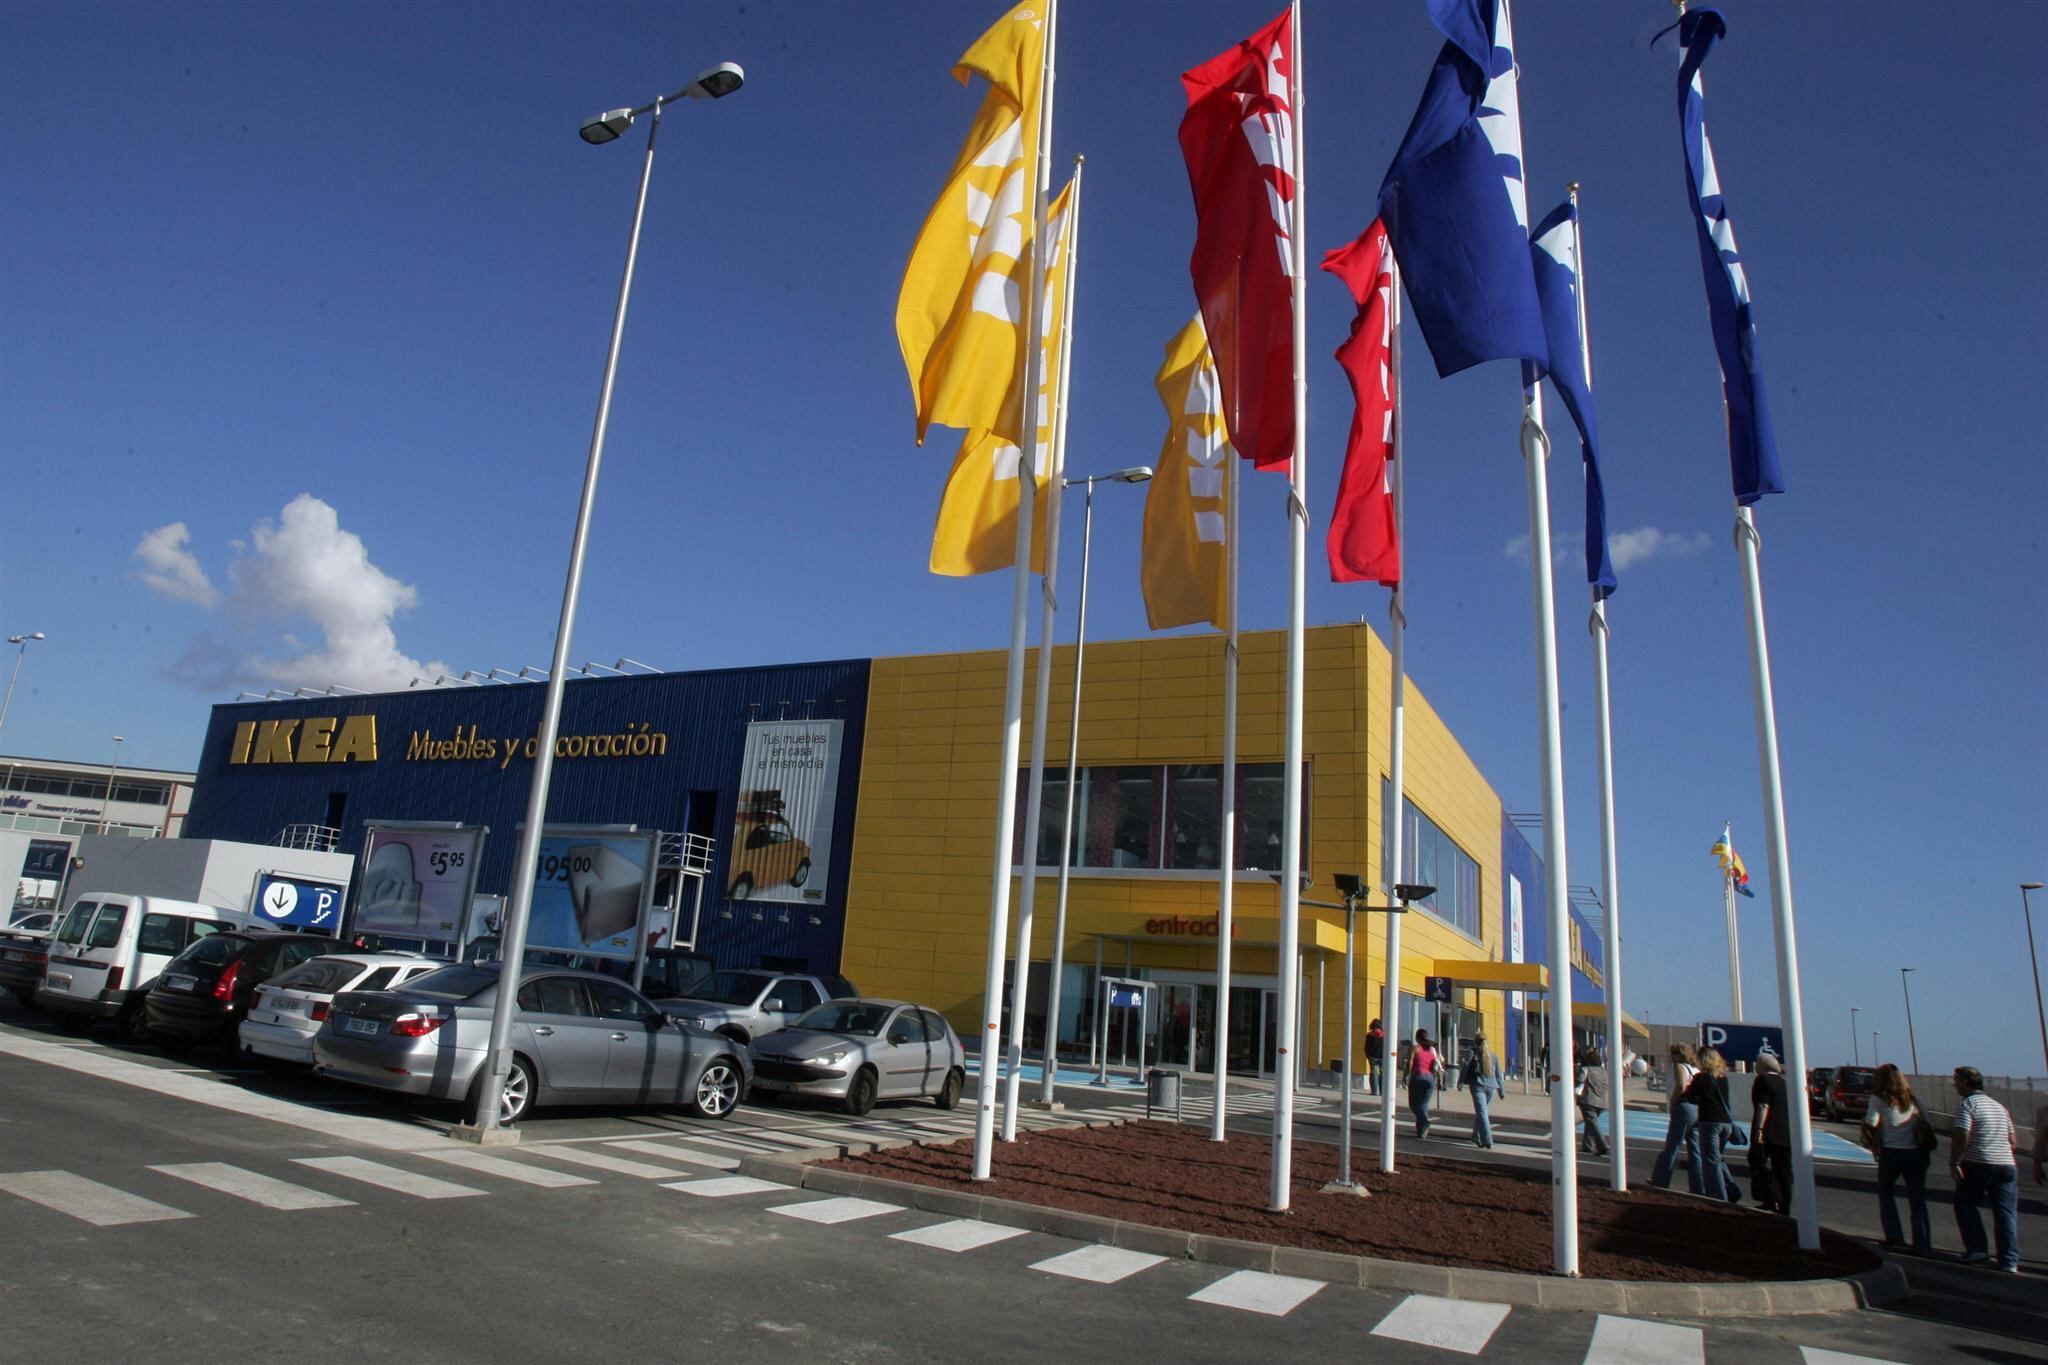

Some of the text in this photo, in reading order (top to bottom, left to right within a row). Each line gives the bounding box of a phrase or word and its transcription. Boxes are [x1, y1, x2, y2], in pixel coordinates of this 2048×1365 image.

[229, 714, 377, 764] IKEA
[405, 722, 667, 769] Muebles y dcoración
[763, 732, 827, 744] Tus muebles
[772, 747, 812, 757] en casa
[770, 759, 804, 769] mismo
[317, 893, 332, 916] P
[1146, 910, 1239, 937] entrad
[1707, 1026, 1727, 1047] P
